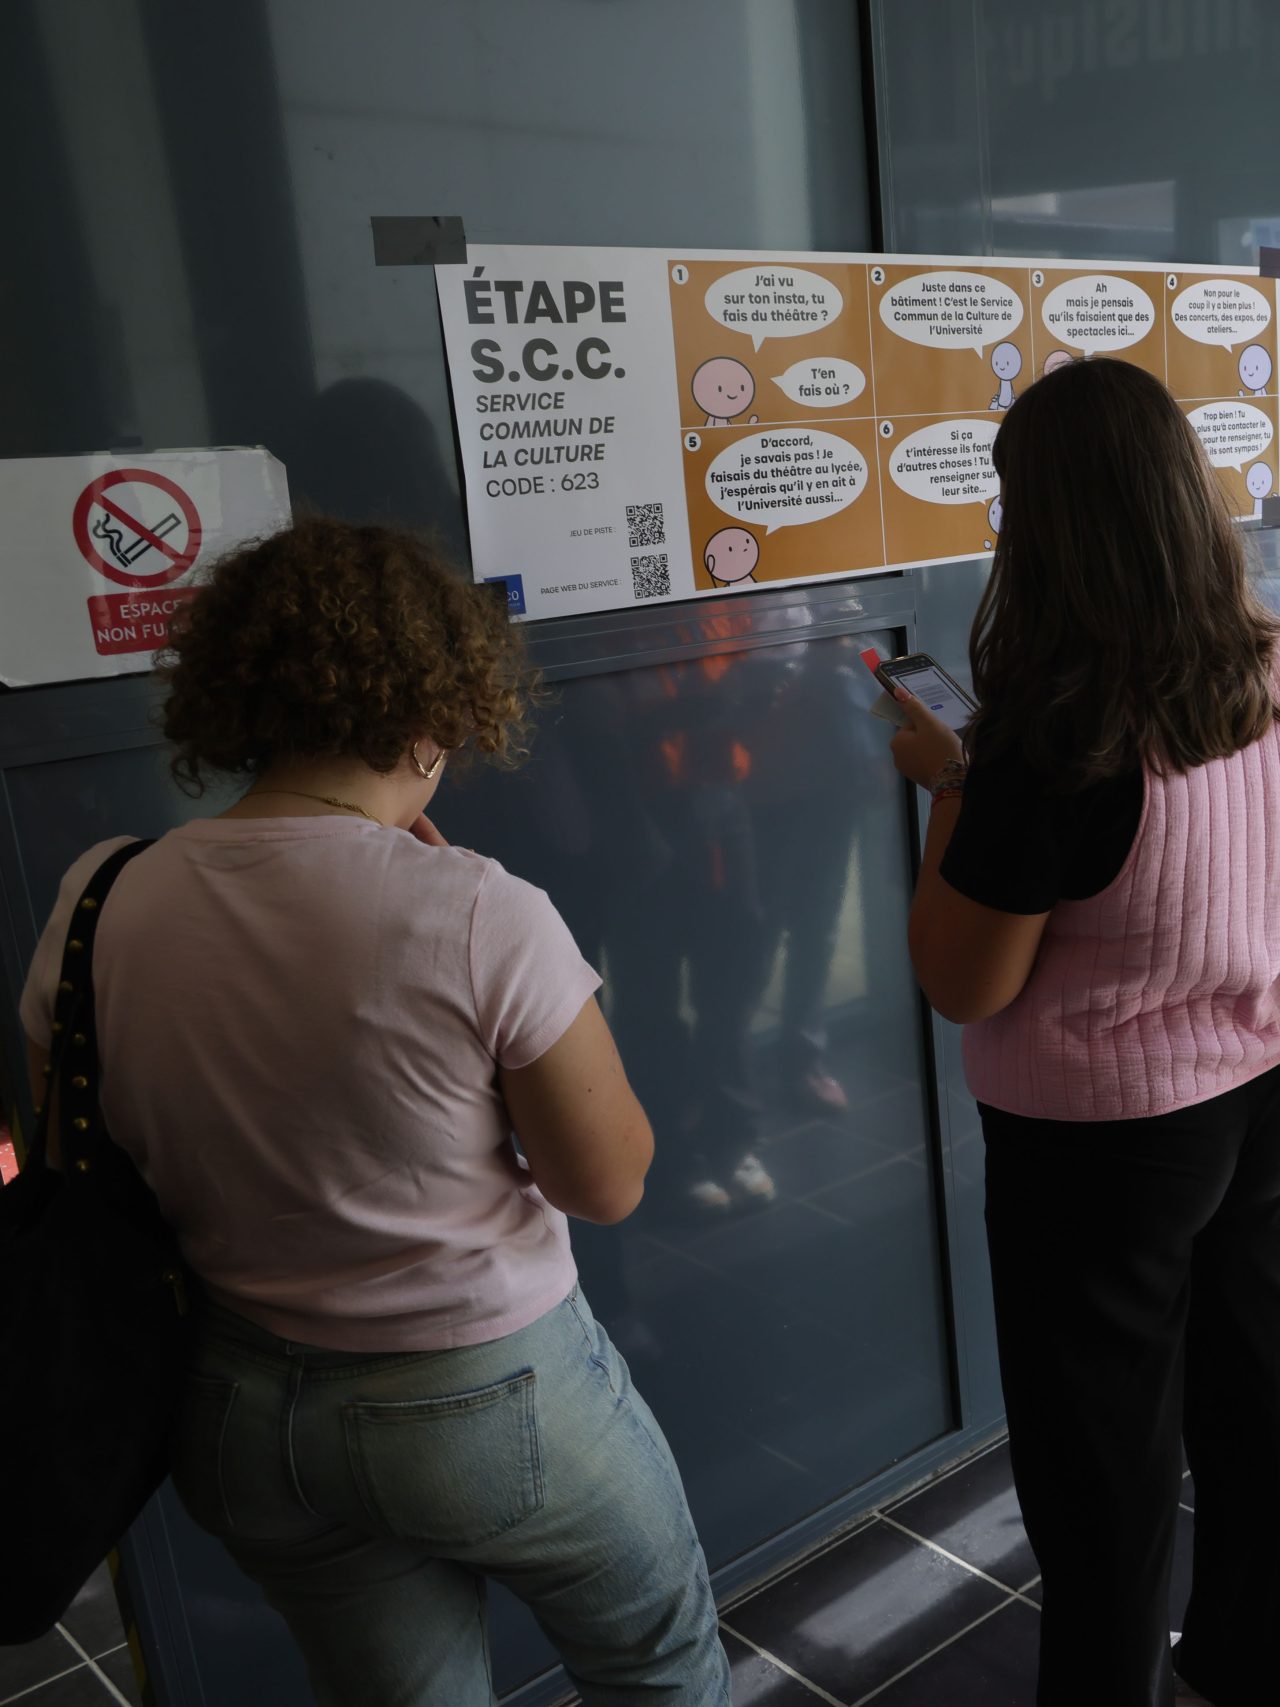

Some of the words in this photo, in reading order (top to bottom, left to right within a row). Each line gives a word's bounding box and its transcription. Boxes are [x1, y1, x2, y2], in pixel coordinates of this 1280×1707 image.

[677, 269, 683, 280] 1
[755, 274, 775, 287] J'ai
[778, 278, 794, 287] vu
[875, 271, 881, 281] 2
[1036, 274, 1041, 283] 3
[922, 283, 946, 292] Juste
[949, 283, 972, 292] dans
[1096, 283, 1107, 293] Ah
[1170, 278, 1174, 286] 4
[463, 266, 626, 325] ÉTAPE
[724, 295, 745, 304] sur
[749, 293, 770, 304] ton
[773, 292, 809, 305] insta,
[812, 293, 824, 304] tu
[1204, 289, 1216, 297] Non
[1218, 291, 1232, 299] pour
[1234, 289, 1240, 297] le
[891, 296, 937, 307] bâtiment
[944, 297, 967, 306] C'est
[970, 297, 978, 306] le
[981, 297, 1013, 306] Service
[1066, 297, 1088, 307] mais
[1091, 297, 1099, 309] je
[1101, 297, 1133, 309] pensais
[1189, 303, 1204, 311] coup
[1207, 301, 1210, 309] il
[1212, 303, 1215, 311] y
[1223, 301, 1236, 309] bien
[1238, 302, 1251, 311] plus
[723, 309, 748, 321] fais
[751, 310, 767, 321] du
[771, 309, 818, 321] théâtre
[894, 312, 938, 321] Commun
[941, 312, 952, 321] de
[955, 312, 963, 320] la
[966, 312, 999, 320] Culture
[1001, 312, 1012, 320] de
[1049, 312, 1074, 323] qu'ils
[1076, 312, 1115, 321] faisaient
[1118, 313, 1133, 323] que
[1135, 312, 1149, 321] des
[1189, 314, 1219, 322] concerts,
[1257, 313, 1267, 321] des
[930, 325, 982, 335] l'Université
[1067, 326, 1116, 338] spectacles
[470, 337, 626, 383] S.C.C.
[811, 369, 835, 379] T'en
[799, 384, 822, 396] fais
[825, 383, 840, 395] où
[476, 392, 565, 413] SERVICE
[1204, 413, 1217, 421] Trop
[1219, 411, 1233, 419] bien
[1238, 410, 1245, 418] Tu
[479, 418, 582, 441] COMMUN
[589, 416, 615, 434] DE
[883, 424, 889, 434] 6
[1197, 424, 1211, 433] plus
[1213, 423, 1226, 433] qu'à
[1228, 422, 1258, 430] contacter
[951, 430, 959, 440] Si
[961, 431, 972, 441] ça
[1203, 436, 1217, 445] pour
[1228, 433, 1262, 442] renseigner,
[689, 437, 696, 447] 5
[761, 436, 813, 448] D'accord,
[906, 446, 957, 458] t'intéresse
[960, 444, 970, 453] ils
[973, 443, 991, 452] font
[1219, 446, 1233, 454] sont
[1235, 445, 1258, 453] sympas
[483, 450, 507, 469] LA
[514, 444, 605, 466] CULTURE
[740, 454, 751, 467] je
[754, 452, 791, 465] savais
[794, 452, 814, 463] pas
[823, 449, 833, 459] Je
[897, 462, 937, 472] d'autres
[940, 459, 972, 469] choses
[979, 457, 989, 465] Tu
[711, 469, 750, 483] faisais
[754, 468, 768, 479] du
[771, 466, 812, 478] théâtre
[815, 466, 828, 474] au
[832, 461, 862, 475] lycée,
[930, 471, 979, 484] renseigner
[486, 476, 545, 498] CODE
[561, 472, 599, 491] 623
[720, 482, 776, 499] j'espérais
[779, 479, 803, 494] qu'il
[807, 482, 812, 491] y
[816, 480, 829, 488] en
[832, 477, 847, 487] ait
[849, 476, 856, 486] à
[942, 486, 960, 496] leur
[738, 495, 802, 511] l'Université
[805, 492, 843, 504] aussi...
[594, 527, 613, 535] PISTE
[541, 586, 559, 595] PAGE
[561, 584, 577, 593] WEB
[579, 583, 589, 591] DU
[590, 579, 618, 589] SERVICE
[97, 625, 137, 644] NON
